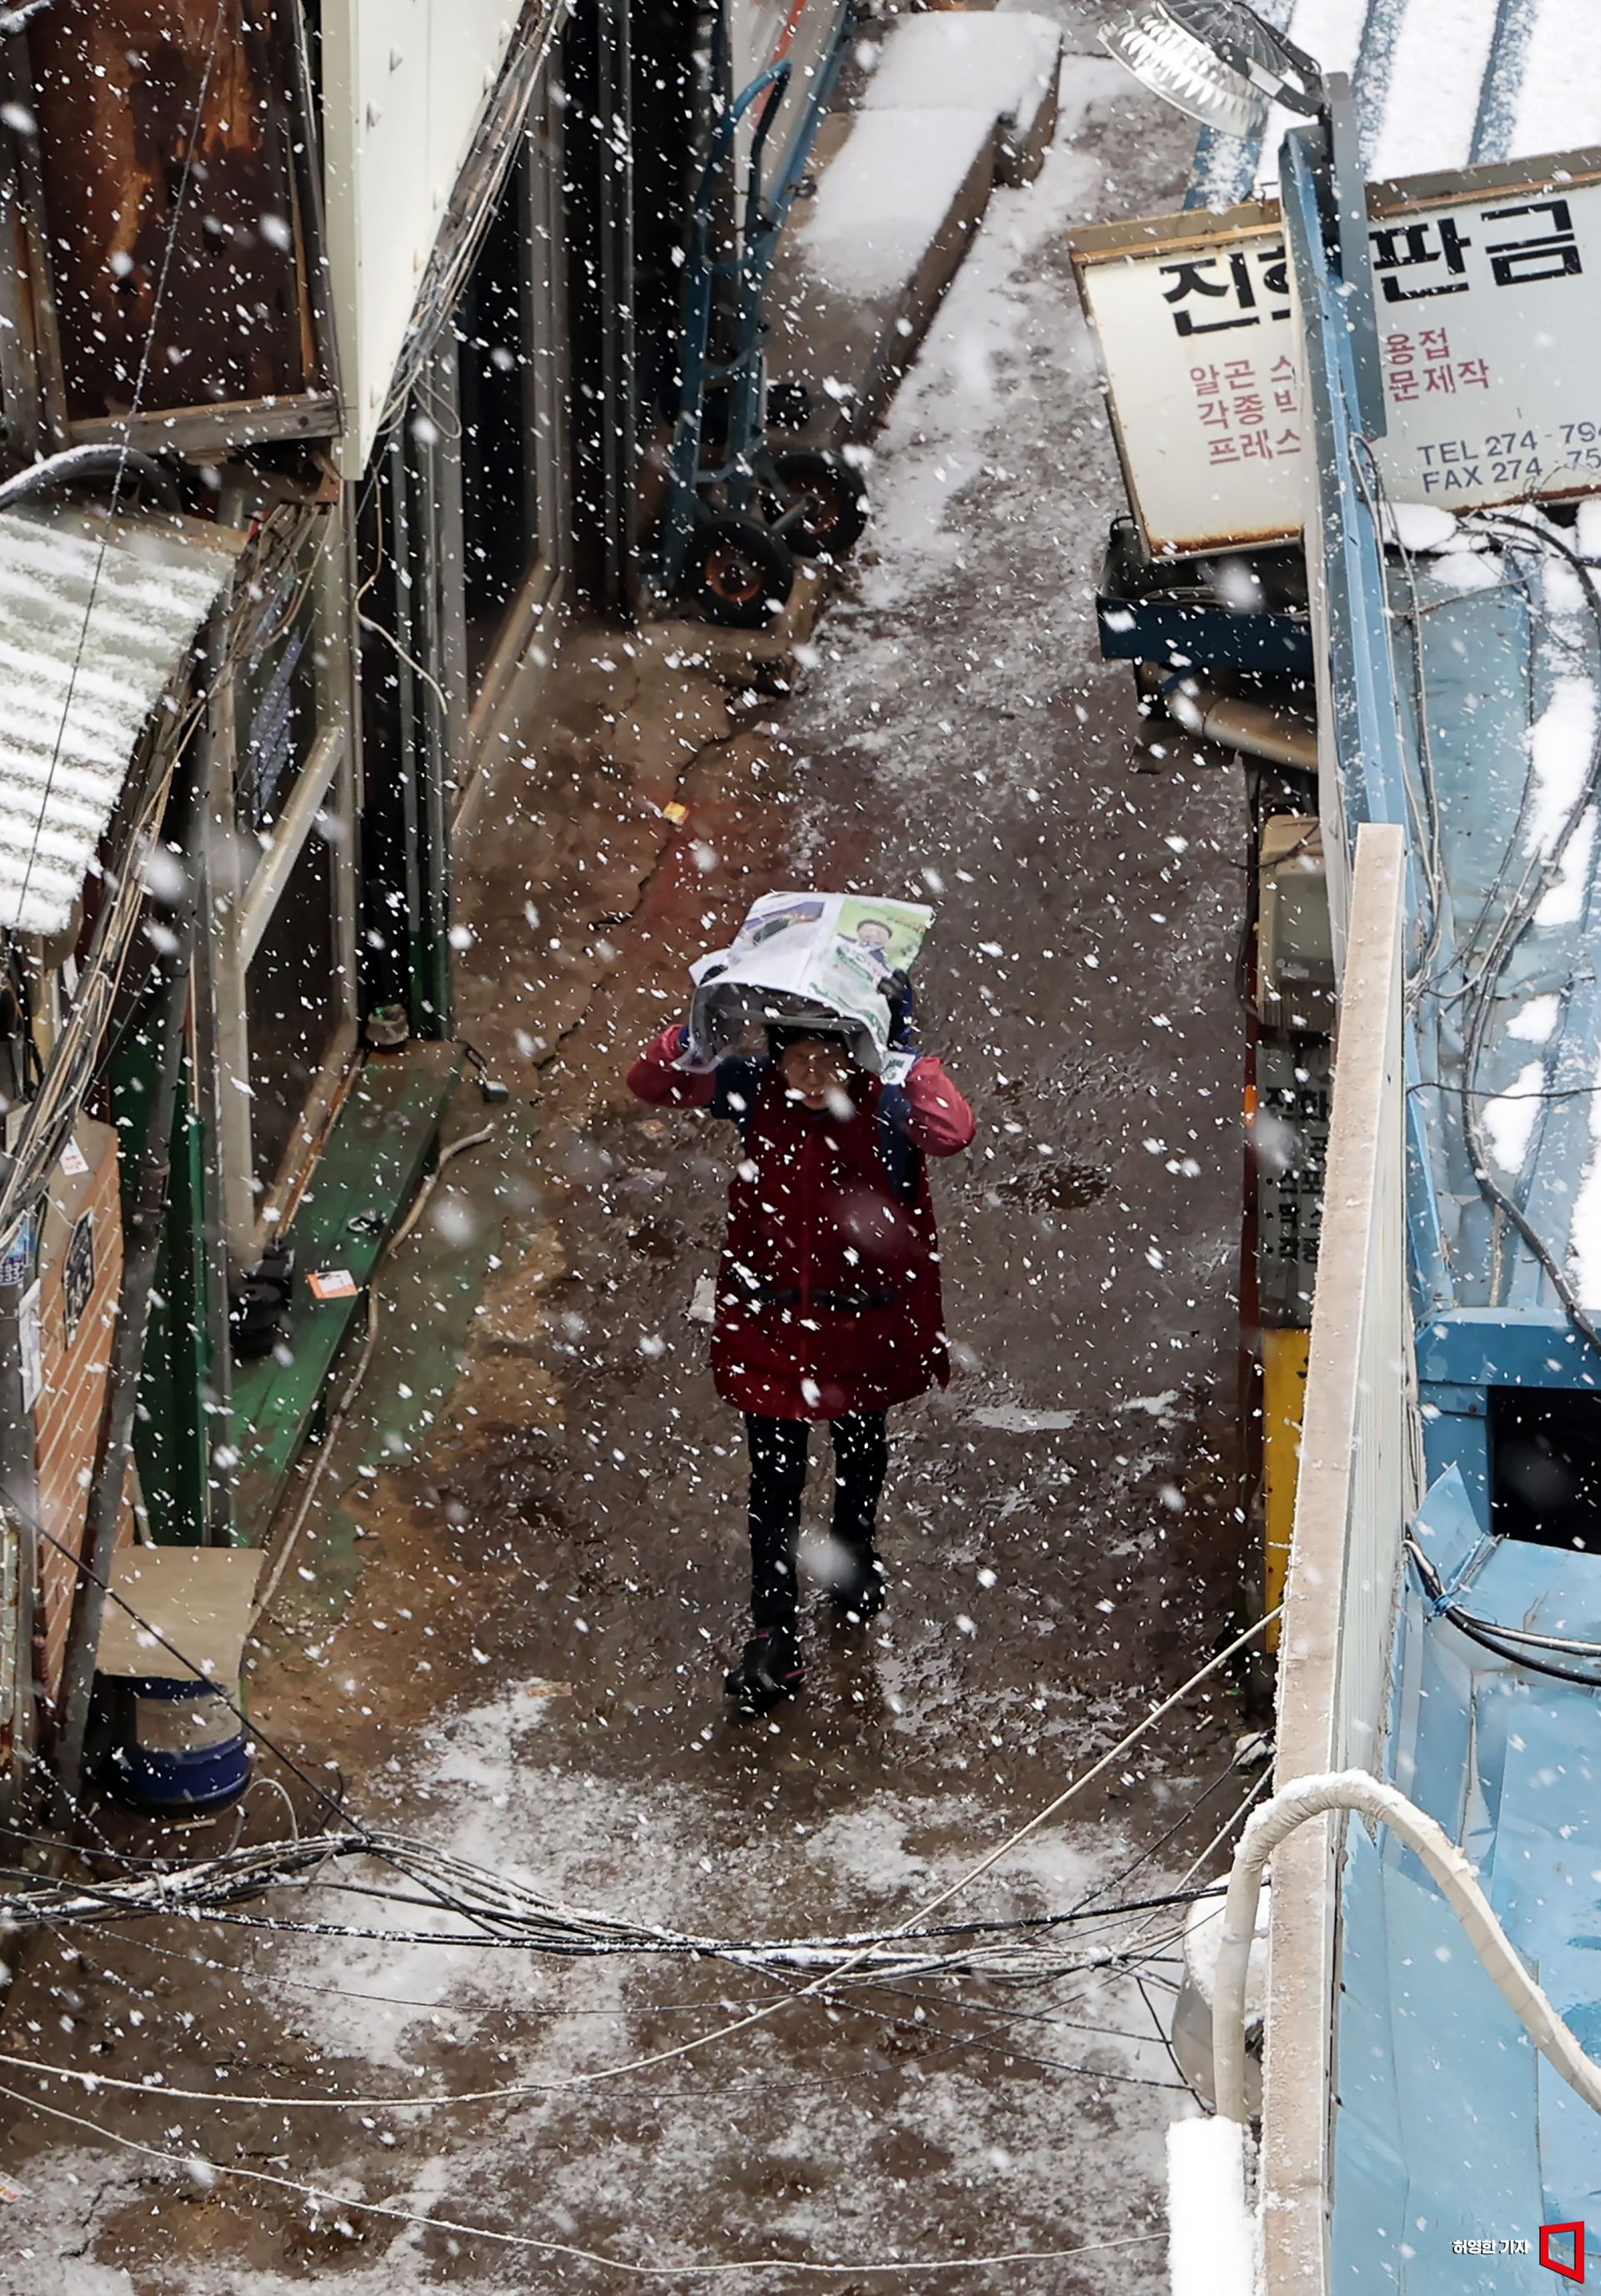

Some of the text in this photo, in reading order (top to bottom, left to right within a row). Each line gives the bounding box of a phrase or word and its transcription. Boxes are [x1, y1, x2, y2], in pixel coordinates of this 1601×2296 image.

[1190, 359, 1255, 396] 알곤
[1197, 393, 1265, 430] 각종
[1208, 429, 1302, 465] 프레스
[1417, 440, 1478, 466] TEL
[1423, 465, 1483, 493] FAX
